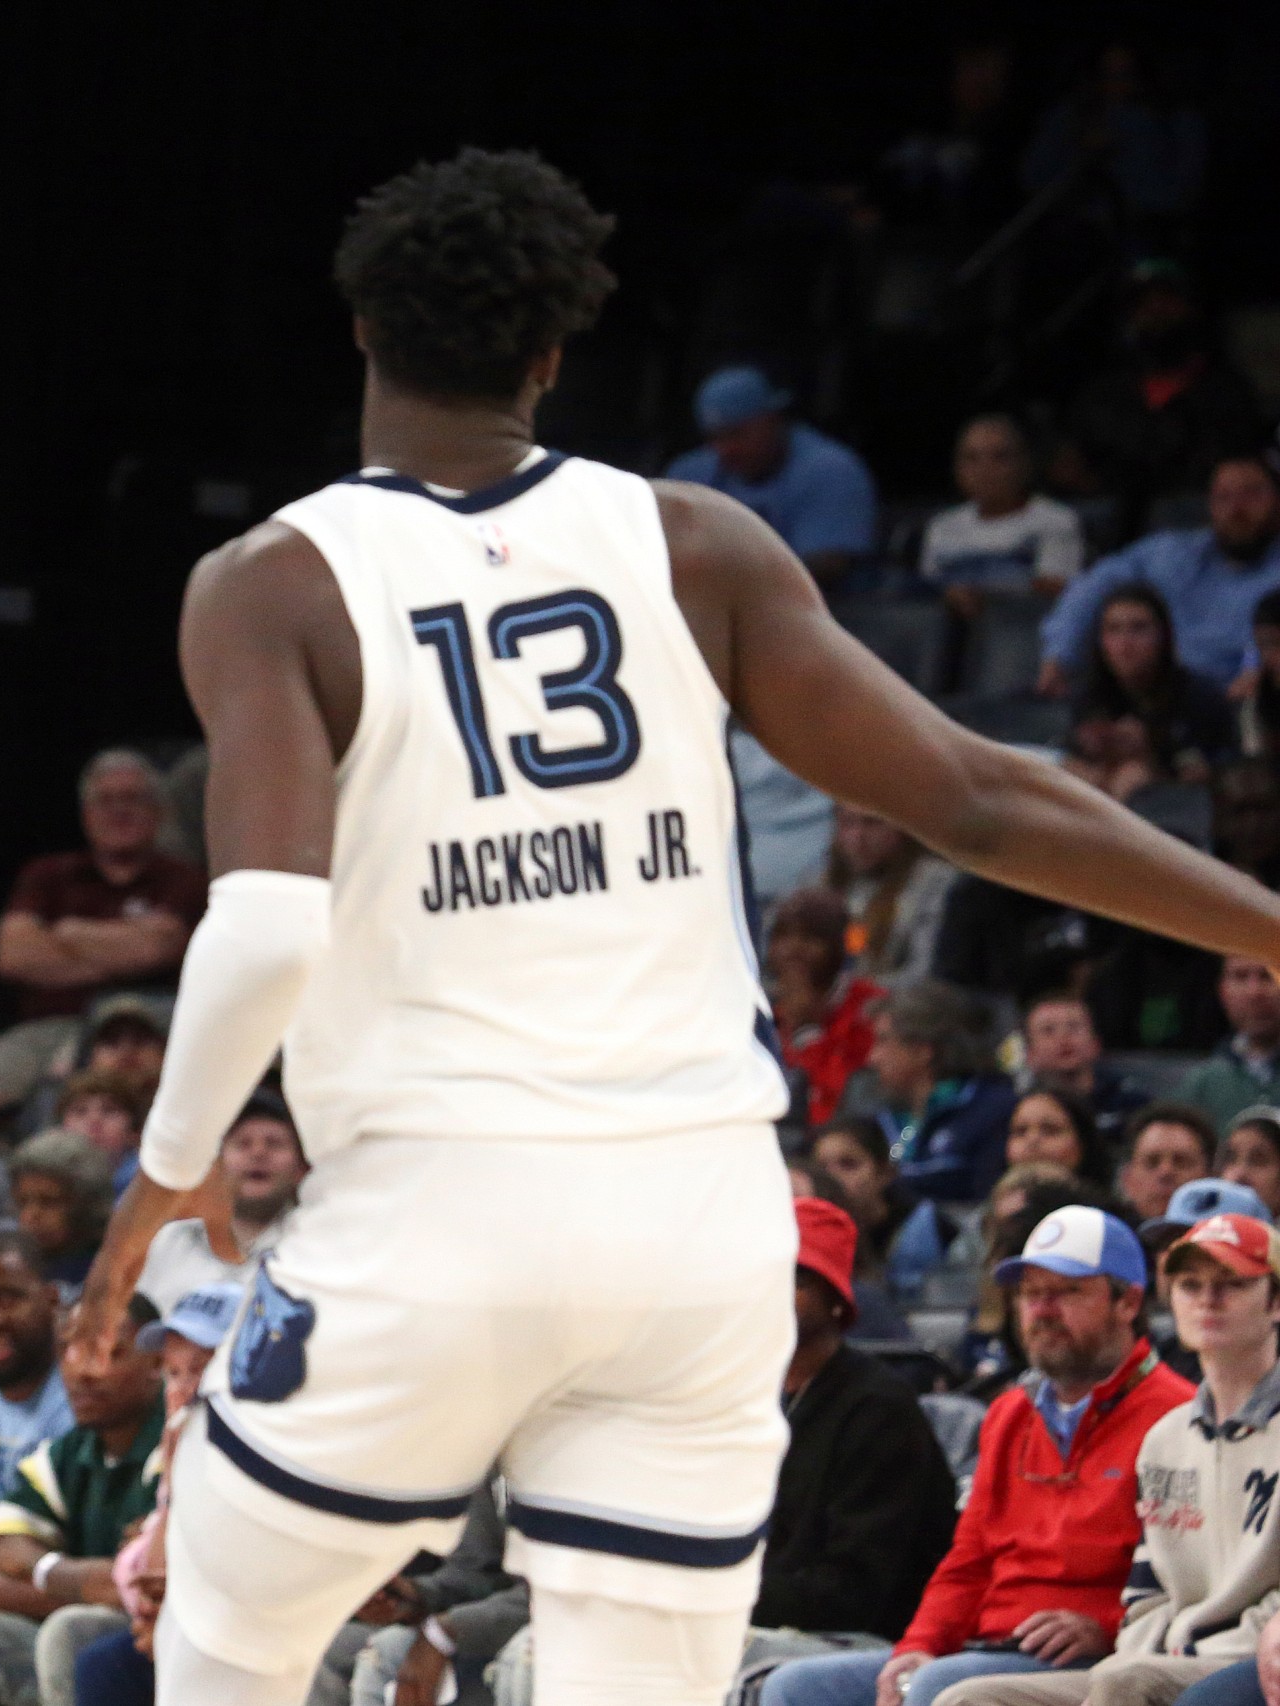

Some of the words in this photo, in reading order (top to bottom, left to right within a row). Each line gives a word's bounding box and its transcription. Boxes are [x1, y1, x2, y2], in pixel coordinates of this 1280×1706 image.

[409, 588, 641, 799] 13
[421, 818, 609, 914] JACKSON
[637, 808, 702, 883] JR.
